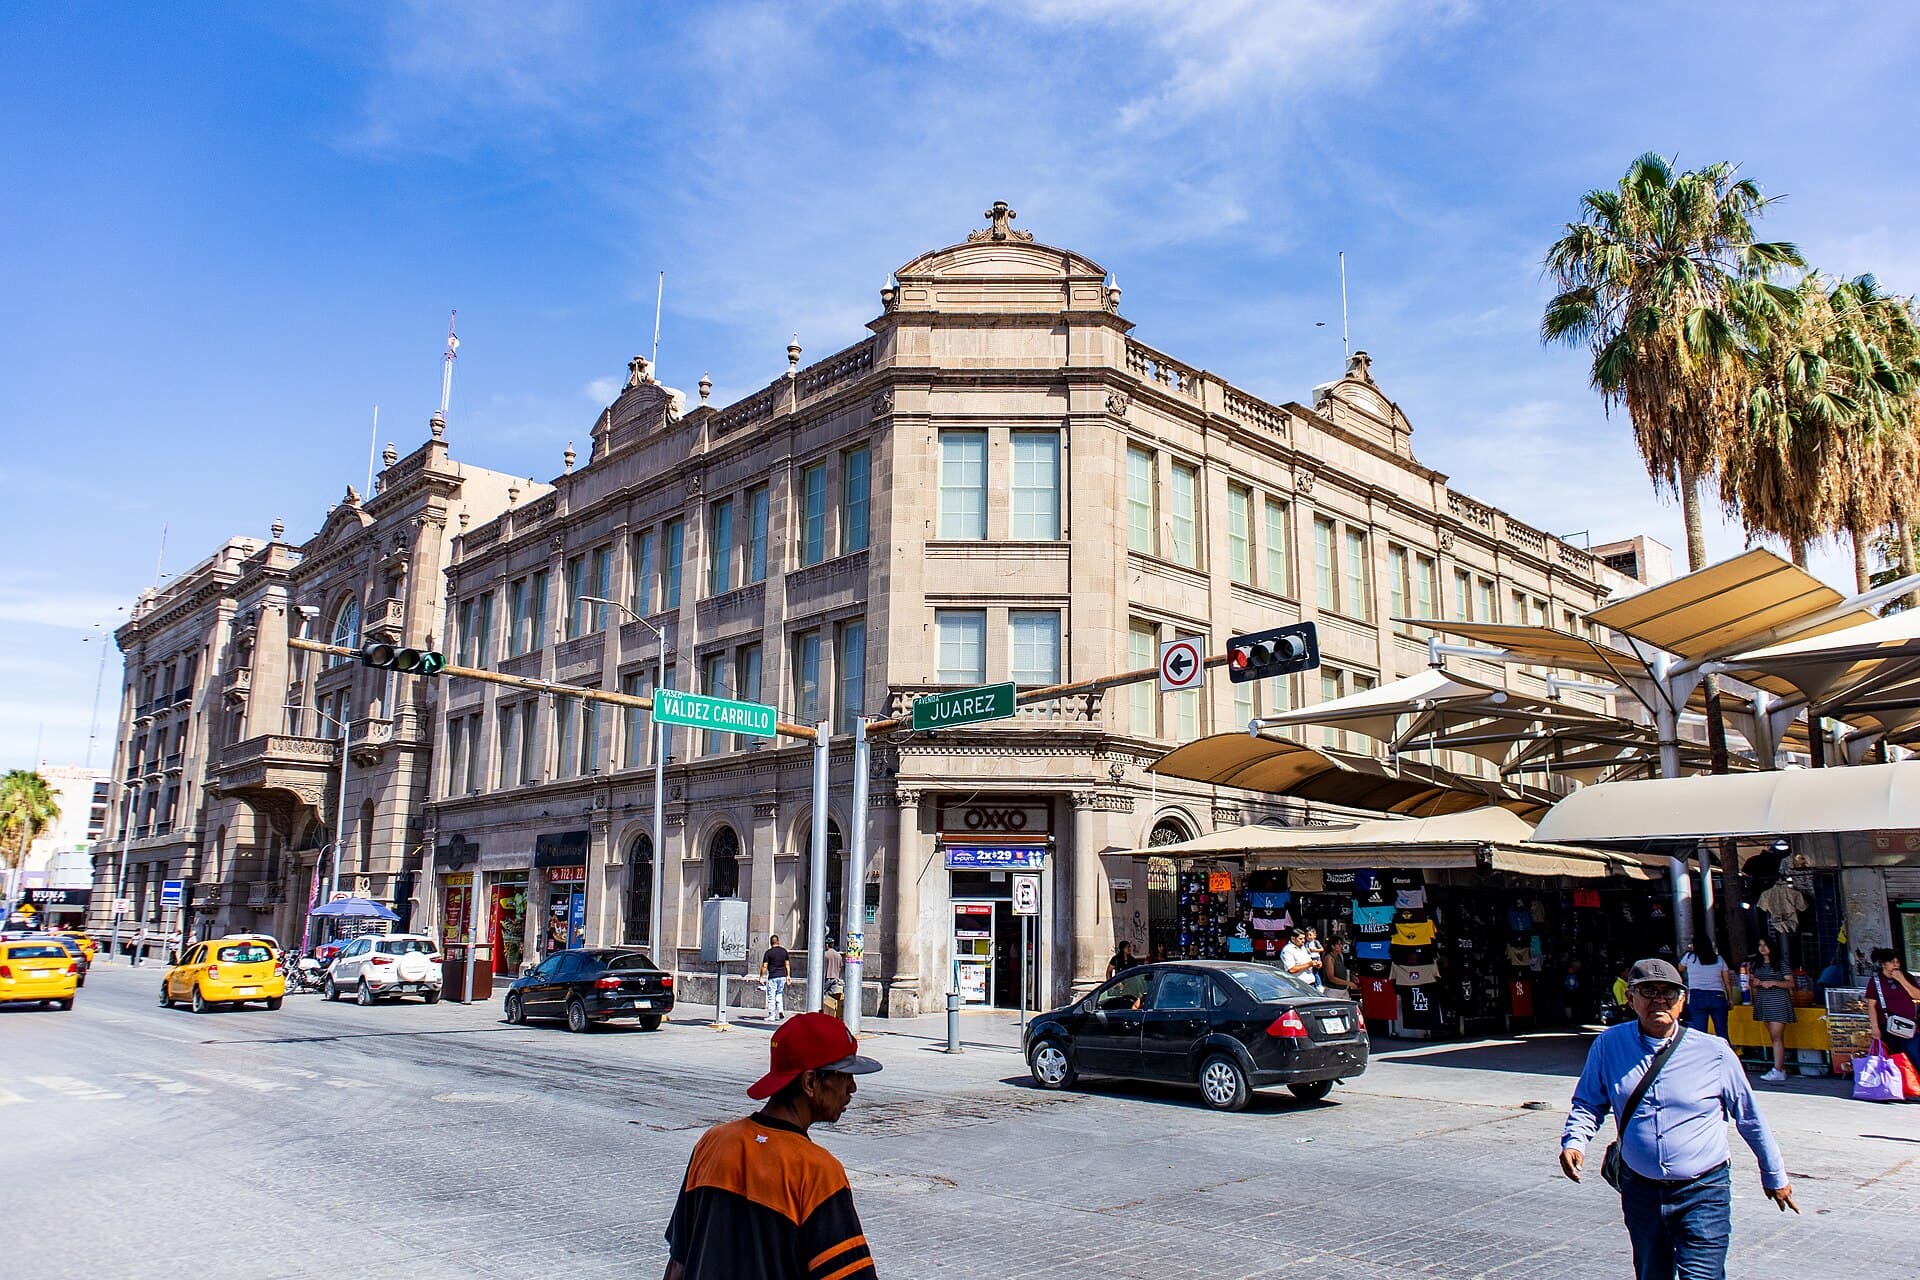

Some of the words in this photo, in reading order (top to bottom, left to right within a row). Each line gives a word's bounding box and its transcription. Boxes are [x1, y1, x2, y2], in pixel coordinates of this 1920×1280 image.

[662, 689, 683, 699] PASEO
[919, 695, 939, 705] AVENIDA
[664, 698, 709, 720] VALDEZ
[713, 705, 768, 728] CARRILLO
[930, 694, 995, 720] JUAREZ
[964, 809, 1027, 829] OXXO
[1412, 987, 1428, 1010] LA
